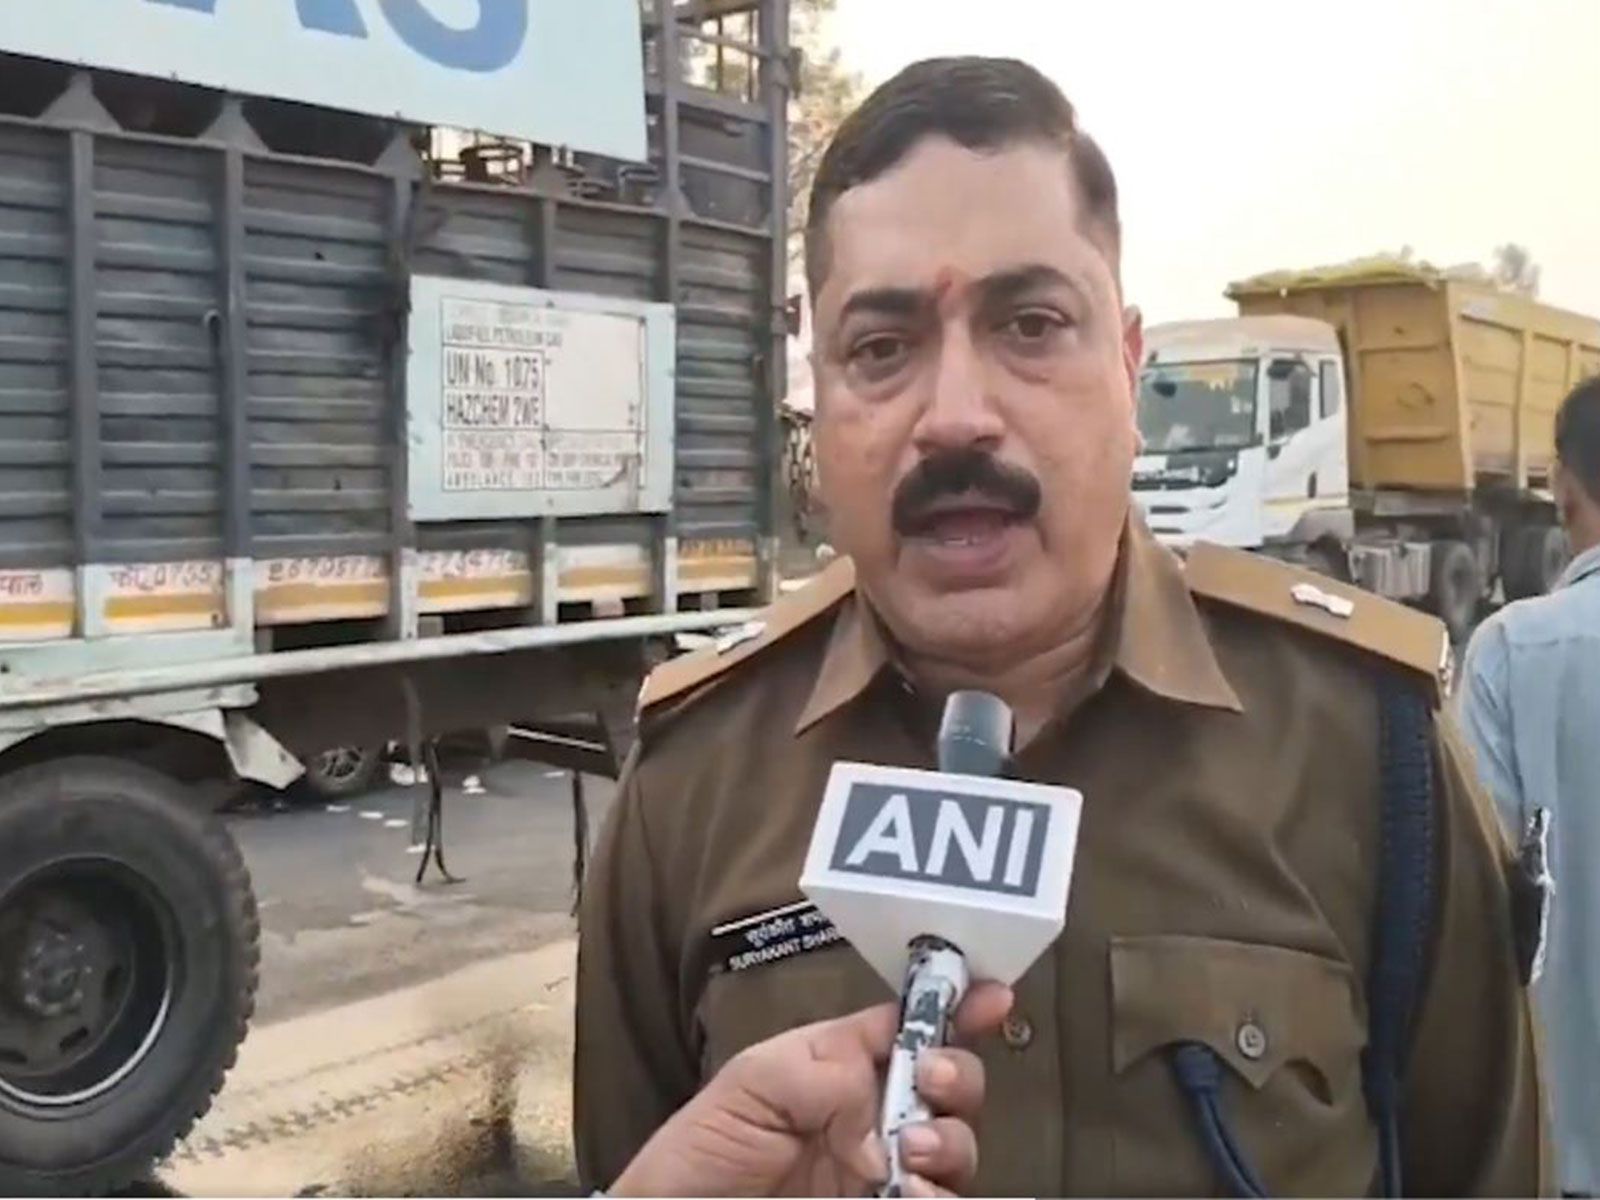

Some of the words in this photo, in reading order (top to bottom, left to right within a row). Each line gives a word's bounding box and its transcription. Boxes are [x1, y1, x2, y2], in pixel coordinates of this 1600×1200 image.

[447, 351, 469, 384] UN
[504, 356, 539, 388] 1075
[446, 393, 509, 424] HAZCHEM
[845, 795, 1035, 886] ANI
[729, 939, 800, 970] SURYAKANT
